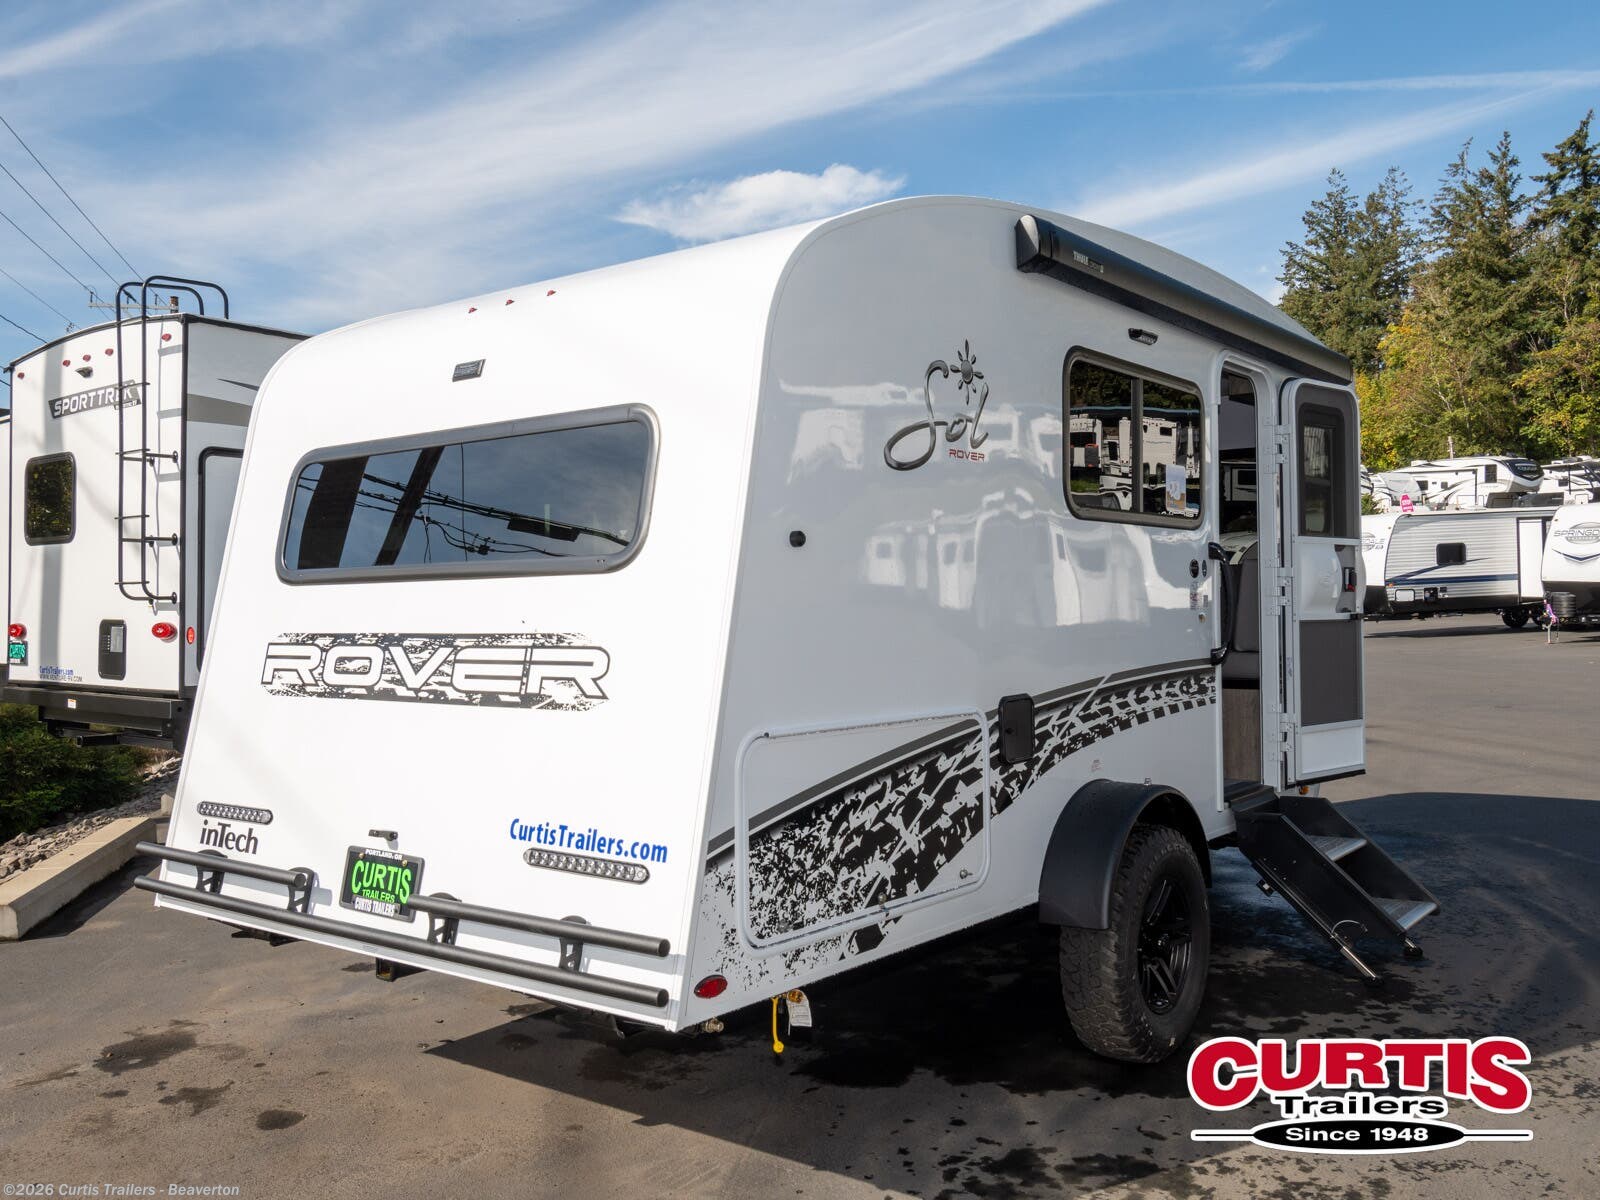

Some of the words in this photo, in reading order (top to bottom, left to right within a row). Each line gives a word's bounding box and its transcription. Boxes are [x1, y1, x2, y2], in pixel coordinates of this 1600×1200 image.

[948, 448, 985, 462] ROVER
[260, 641, 612, 701] ROVER
[200, 819, 259, 855] inTech
[509, 818, 668, 864] CurtisTrailers.com
[351, 860, 412, 904] CURTIS
[362, 889, 396, 903] TRAILERS
[354, 897, 373, 912] CURTIS
[372, 901, 396, 917] TRAILERS
